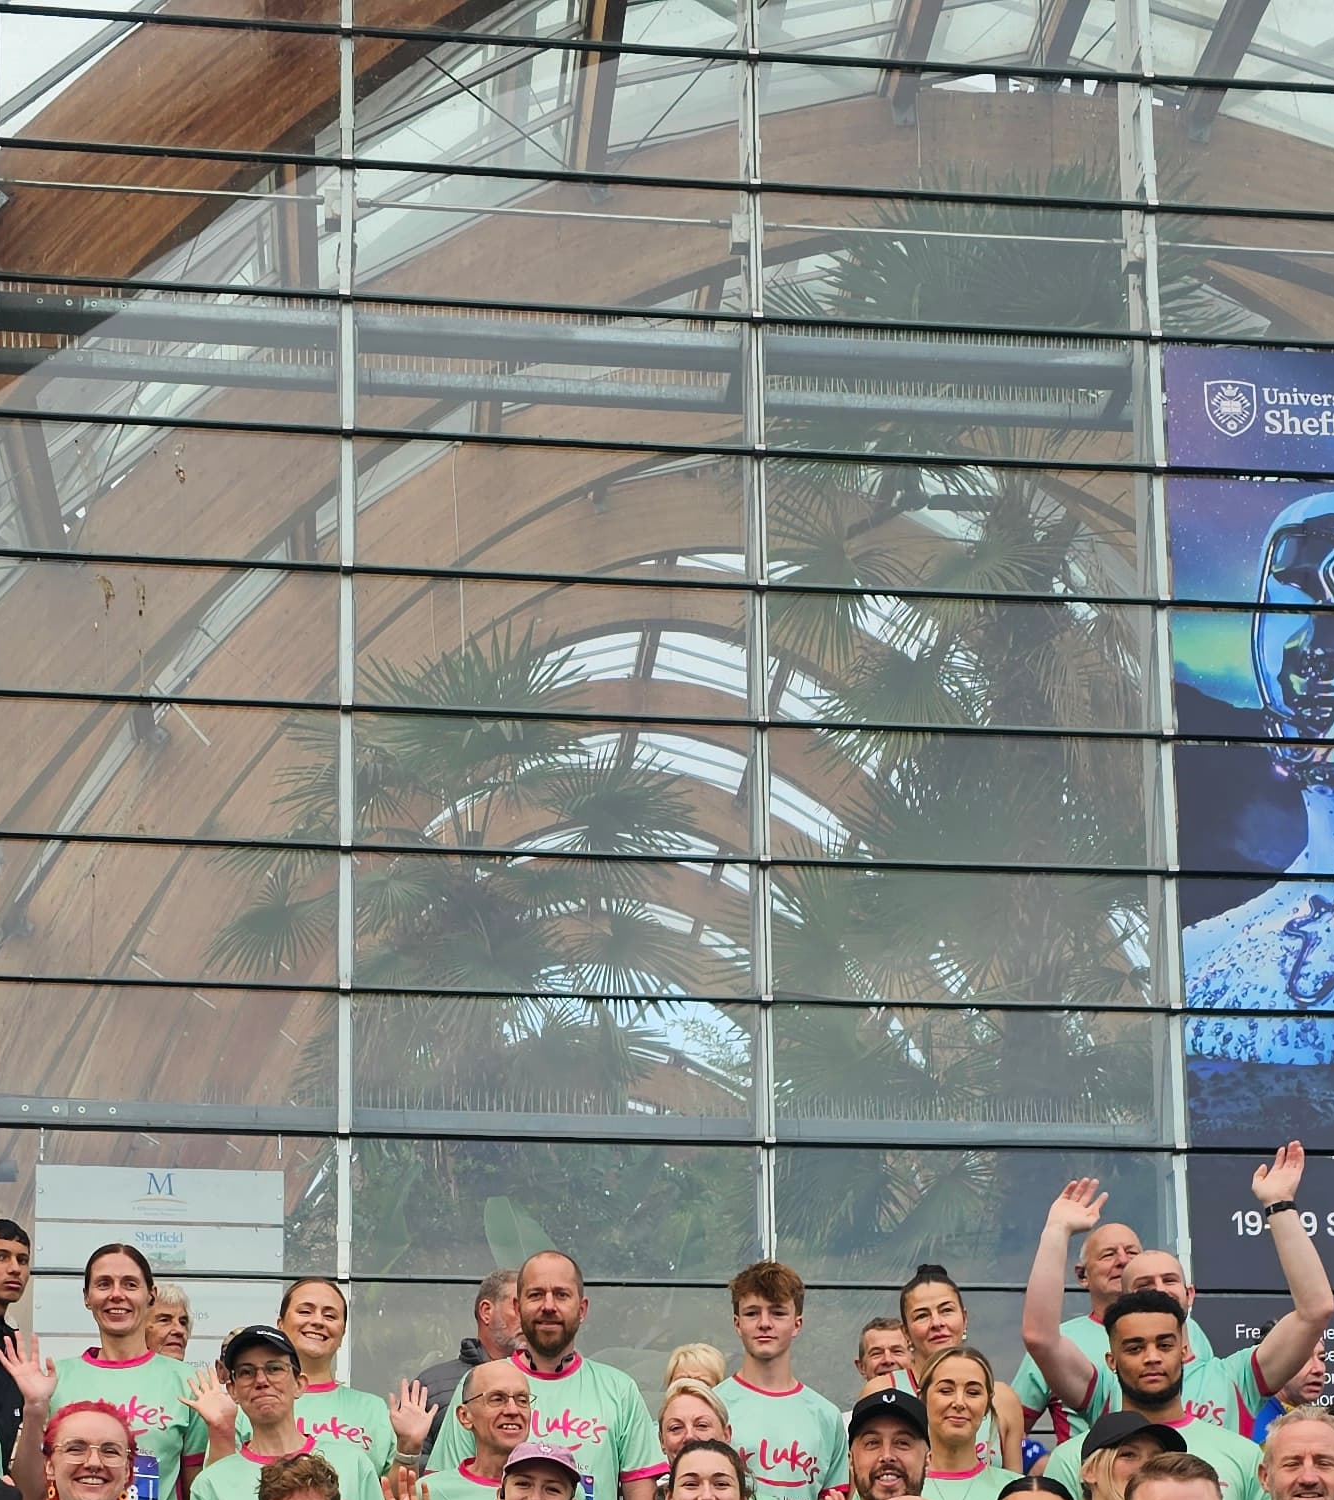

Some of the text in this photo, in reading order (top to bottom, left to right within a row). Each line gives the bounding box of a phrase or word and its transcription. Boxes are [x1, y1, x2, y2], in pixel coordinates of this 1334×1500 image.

[146, 1172, 176, 1197] M
[1231, 1210, 1318, 1237] 19-9
[135, 1231, 184, 1243] Sheffield
[758, 1439, 821, 1485] Luke's
